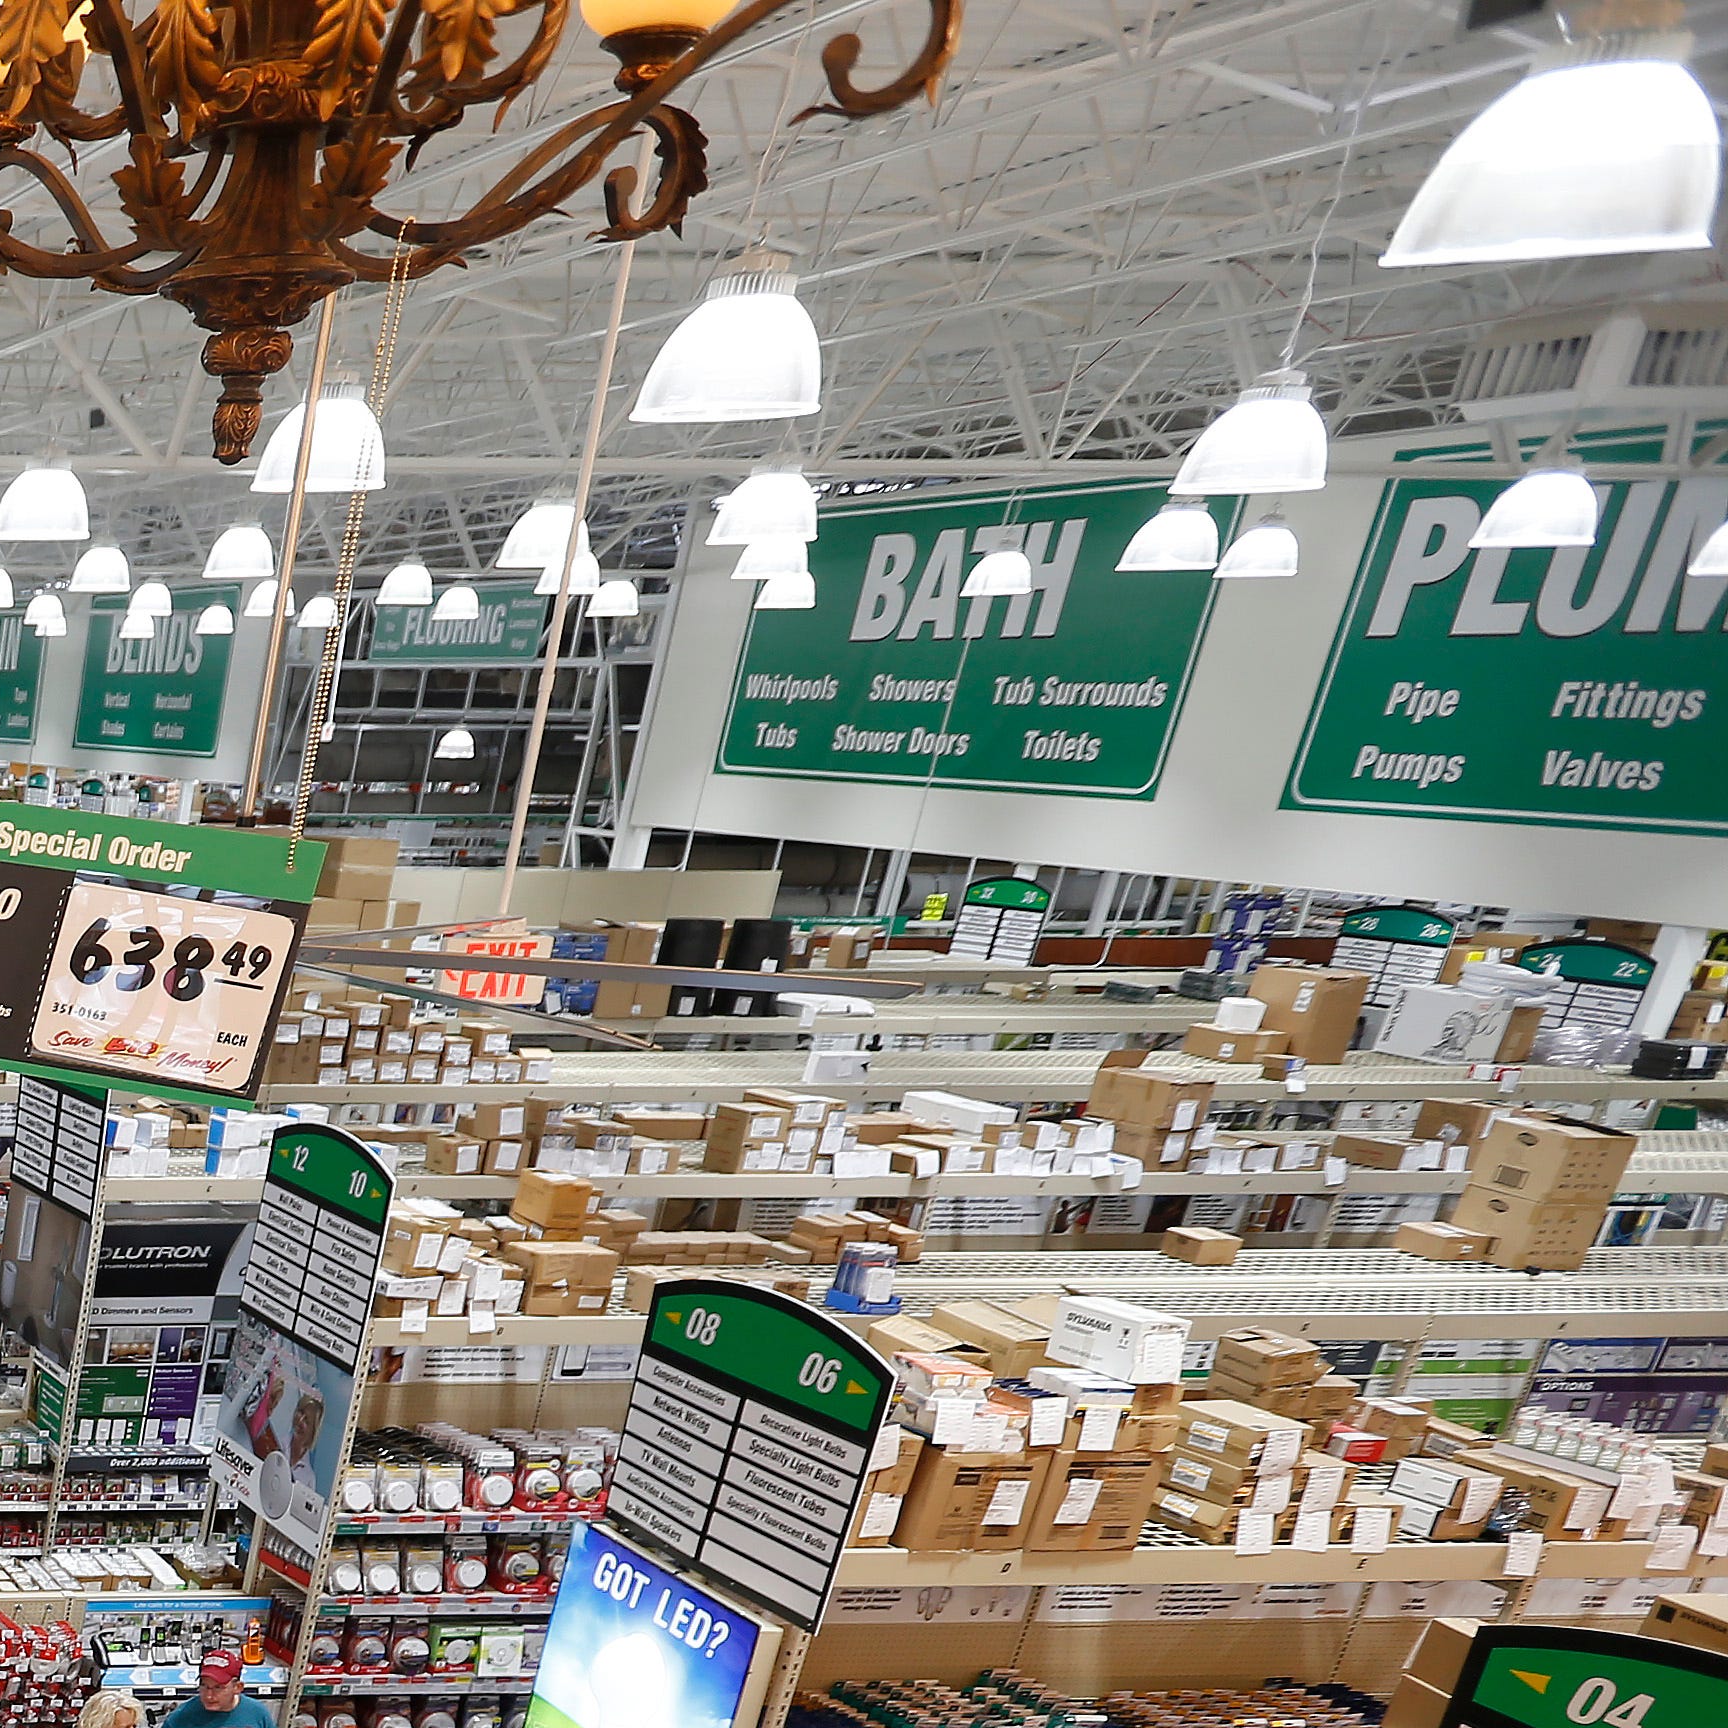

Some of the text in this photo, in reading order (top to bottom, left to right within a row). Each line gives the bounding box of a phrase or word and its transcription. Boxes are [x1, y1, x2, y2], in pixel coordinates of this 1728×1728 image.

[848, 518, 1089, 642] BATH
[745, 673, 1169, 708] Whirlpools Showers Tub Surrounds
[1384, 681, 1707, 729] Pipe Fittings
[755, 722, 1103, 763] Tubs Shower Doors Toilets
[1352, 744, 1665, 791] Pumps Valves
[108, 836, 192, 874] Order
[52, 1002, 248, 1047] 351-0163 EACH
[48, 1030, 234, 1073] Save Money!
[292, 1145, 367, 1198] 12 10
[1065, 1312, 1113, 1334] SYLVANIA
[685, 1307, 842, 1394] 08 06
[1540, 1378, 1596, 1393] OPTIONS
[748, 1438, 840, 1488] Specialty Light Bulbs
[744, 1470, 827, 1516] Fluorescent Tubes
[593, 1552, 731, 1658] GOT LED?
